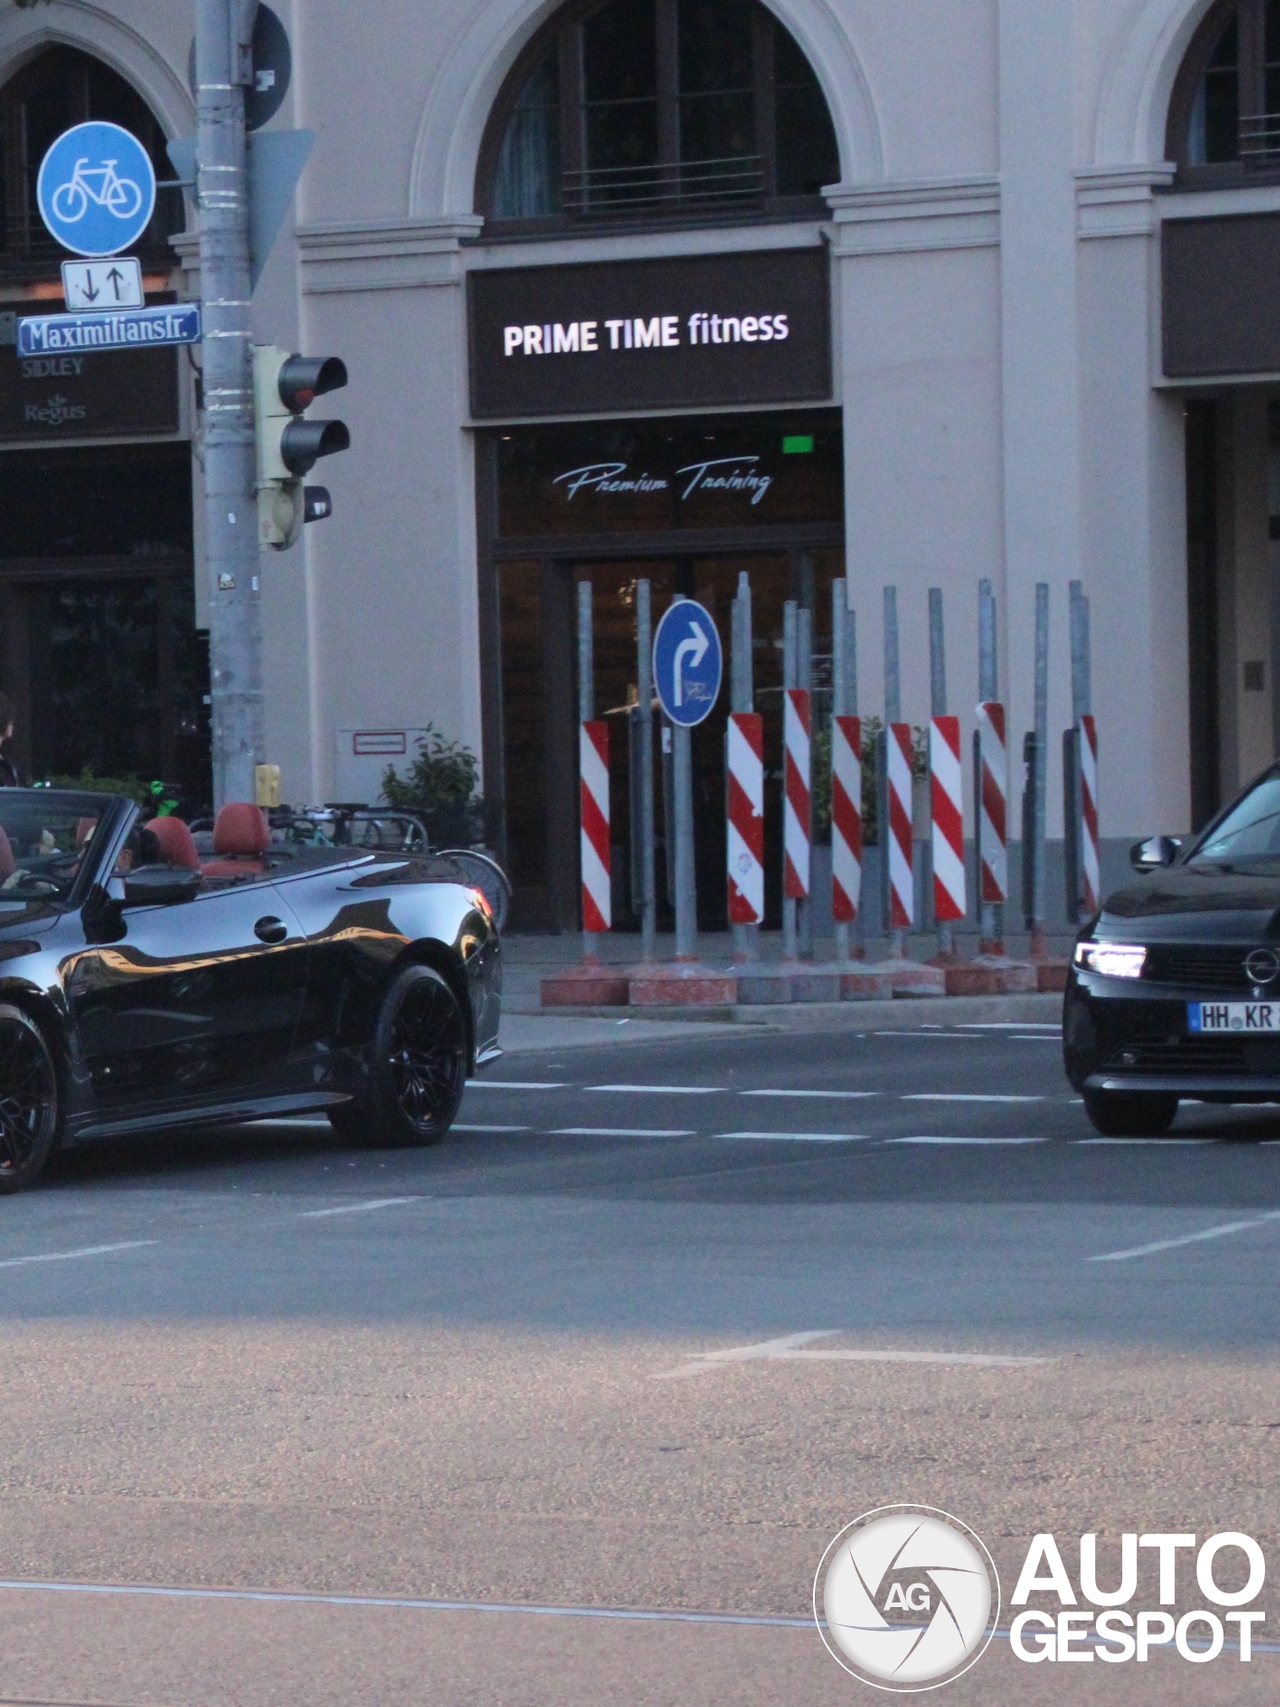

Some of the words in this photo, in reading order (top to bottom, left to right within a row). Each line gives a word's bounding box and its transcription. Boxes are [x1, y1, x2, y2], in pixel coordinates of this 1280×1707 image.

[29, 315, 188, 350] Maximilianstr.
[504, 322, 599, 356] PRIME
[605, 316, 680, 350] TIME
[688, 312, 789, 345] fitness
[22, 357, 84, 378] SIDLEY
[25, 404, 86, 425] Regus
[553, 462, 669, 500] Premium
[676, 456, 773, 505] Training
[1202, 1005, 1229, 1028] HH
[1245, 1005, 1273, 1028] KR
